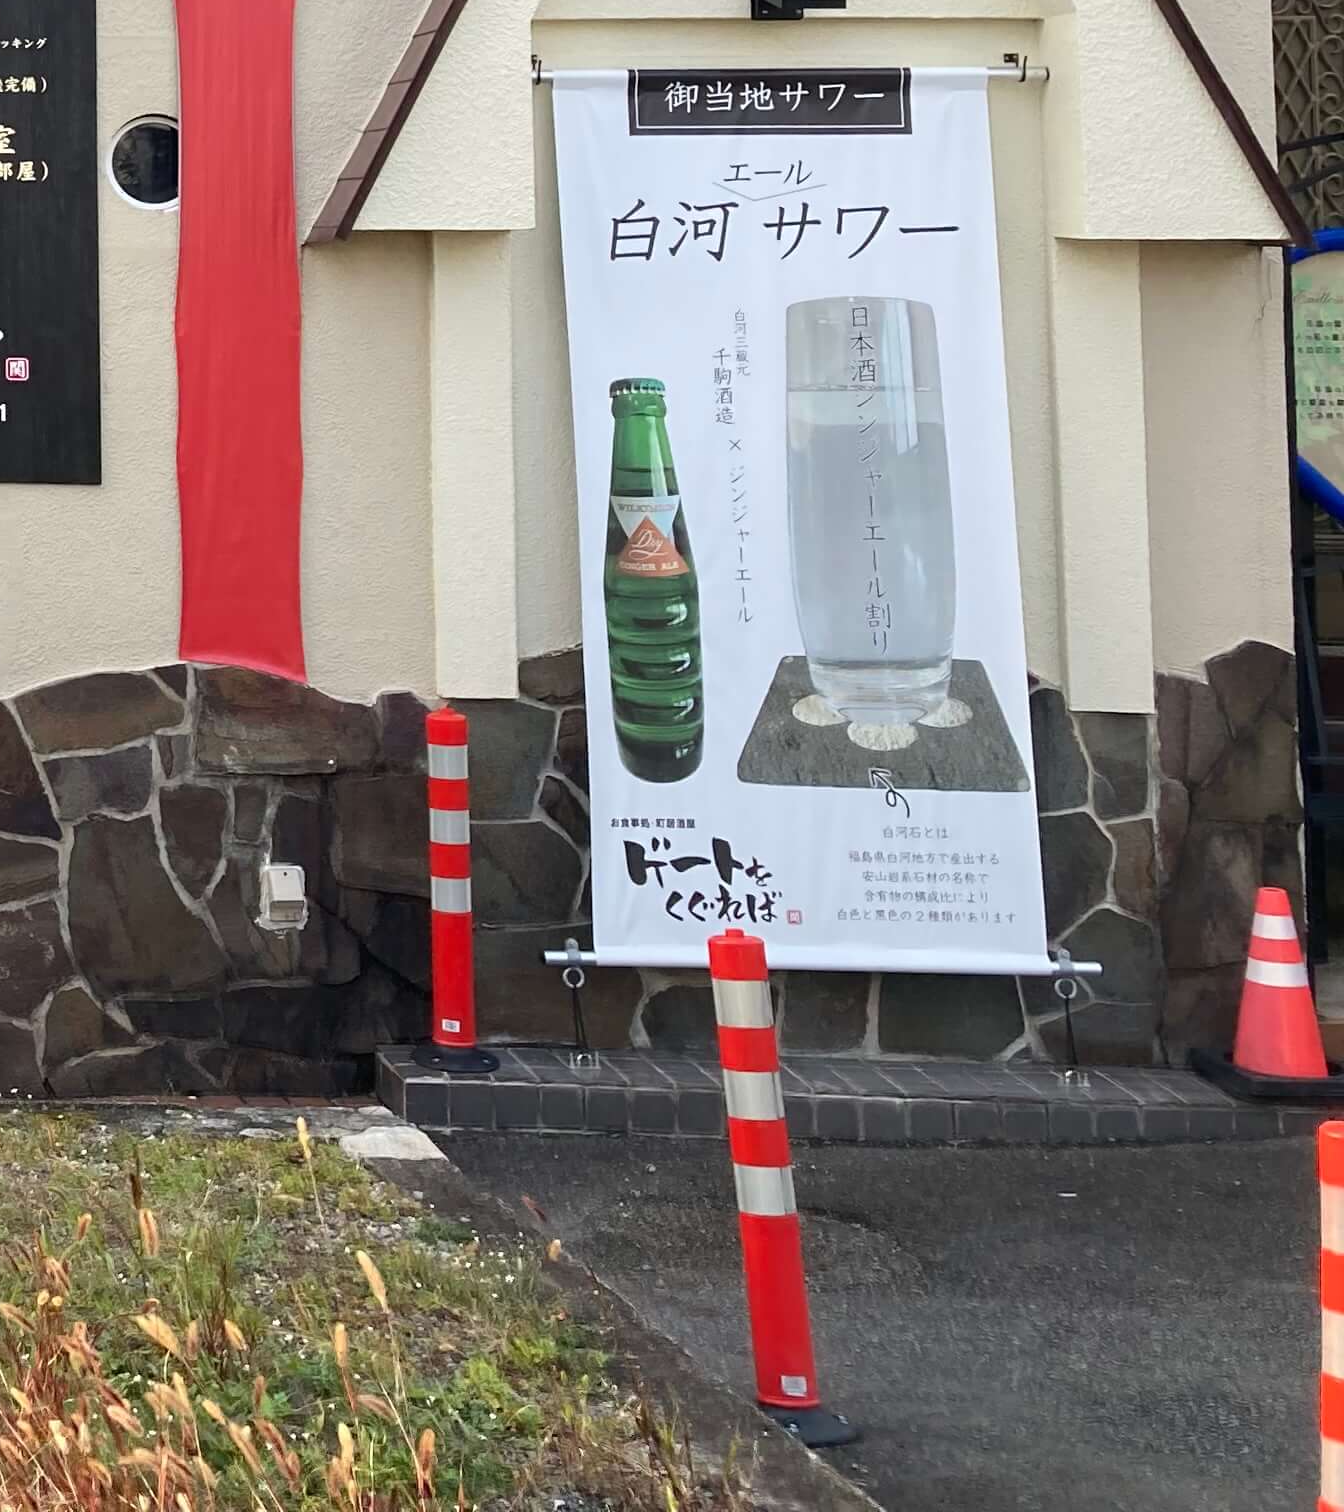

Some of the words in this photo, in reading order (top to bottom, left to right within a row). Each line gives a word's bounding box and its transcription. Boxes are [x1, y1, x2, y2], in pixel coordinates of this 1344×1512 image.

[664, 81, 885, 114] 御当地サワー
[723, 159, 812, 185] エール
[609, 198, 740, 262] 白河
[763, 202, 960, 260] サワー
[882, 826, 949, 840] 白河石とは
